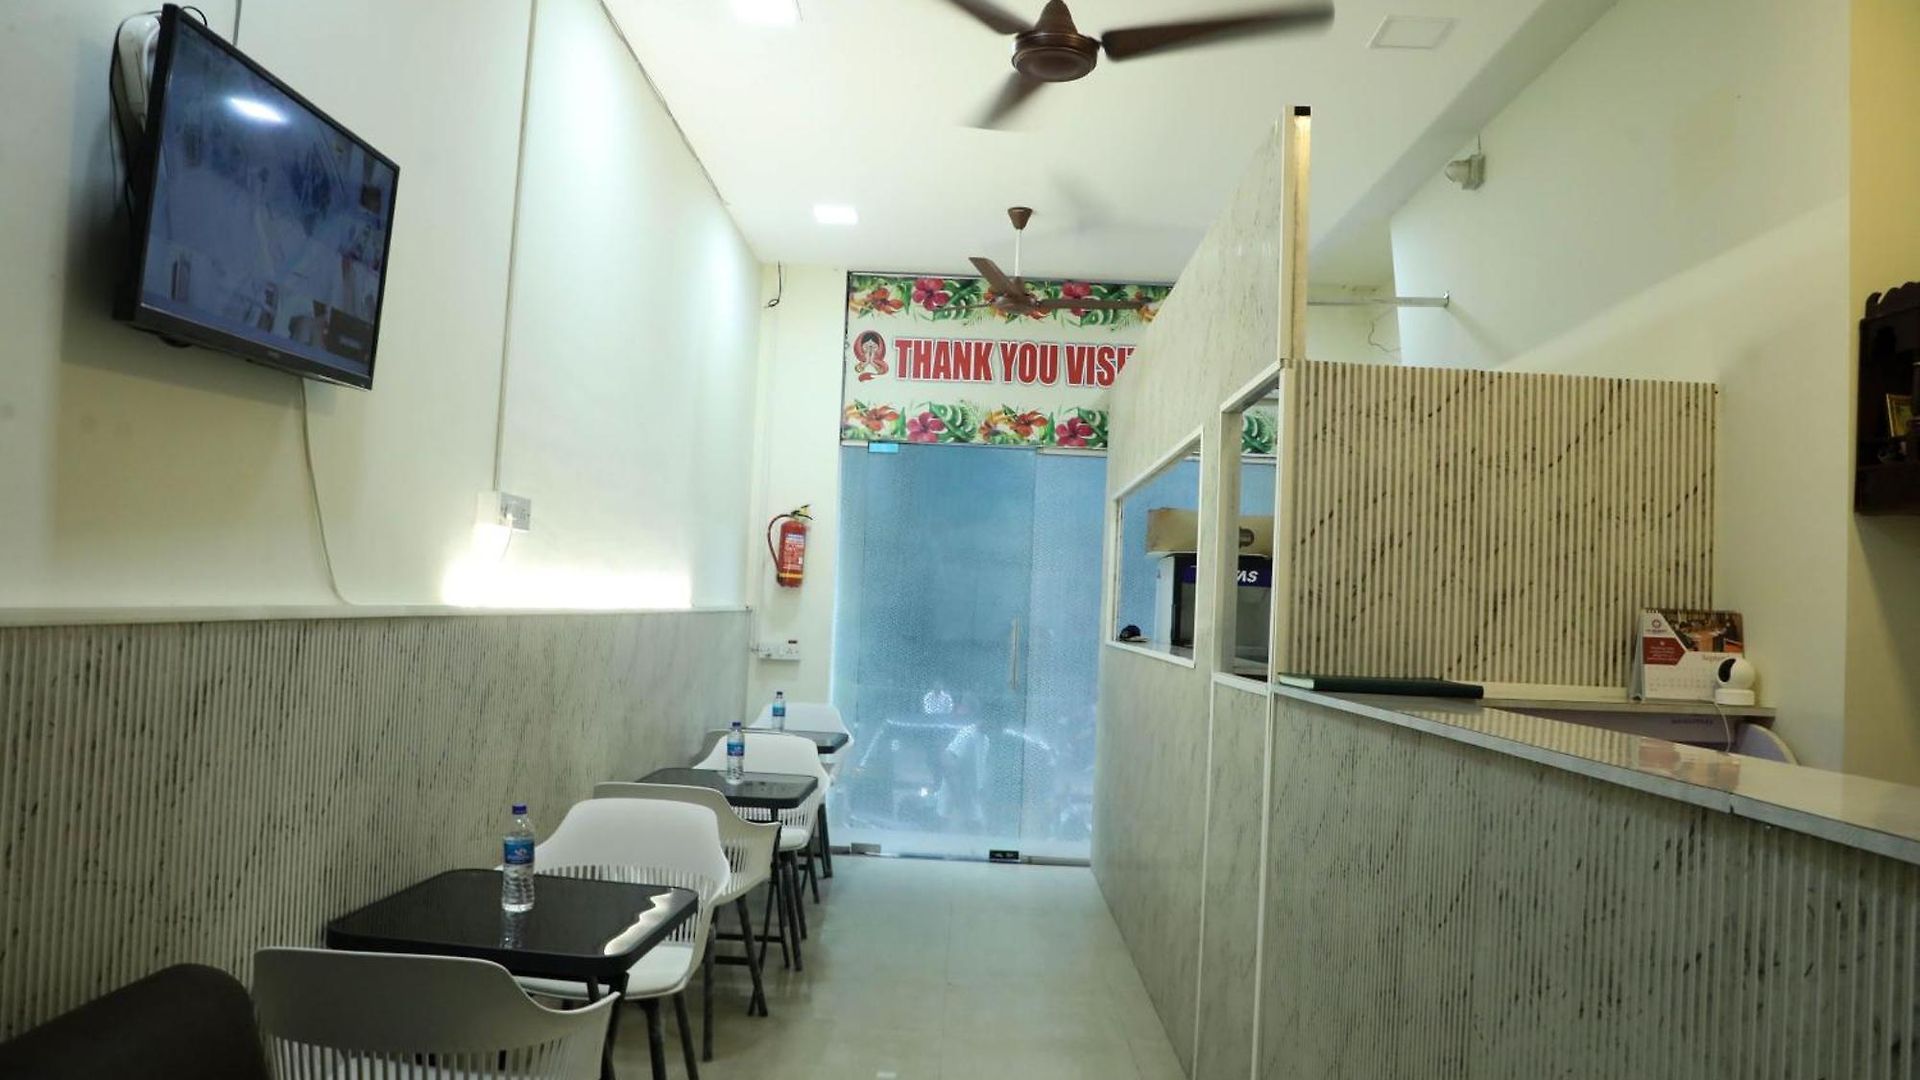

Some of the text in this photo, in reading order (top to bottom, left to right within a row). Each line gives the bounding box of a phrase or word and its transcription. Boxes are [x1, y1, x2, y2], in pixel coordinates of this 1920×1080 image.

[895, 338, 1135, 387] THANK YOU VISI
